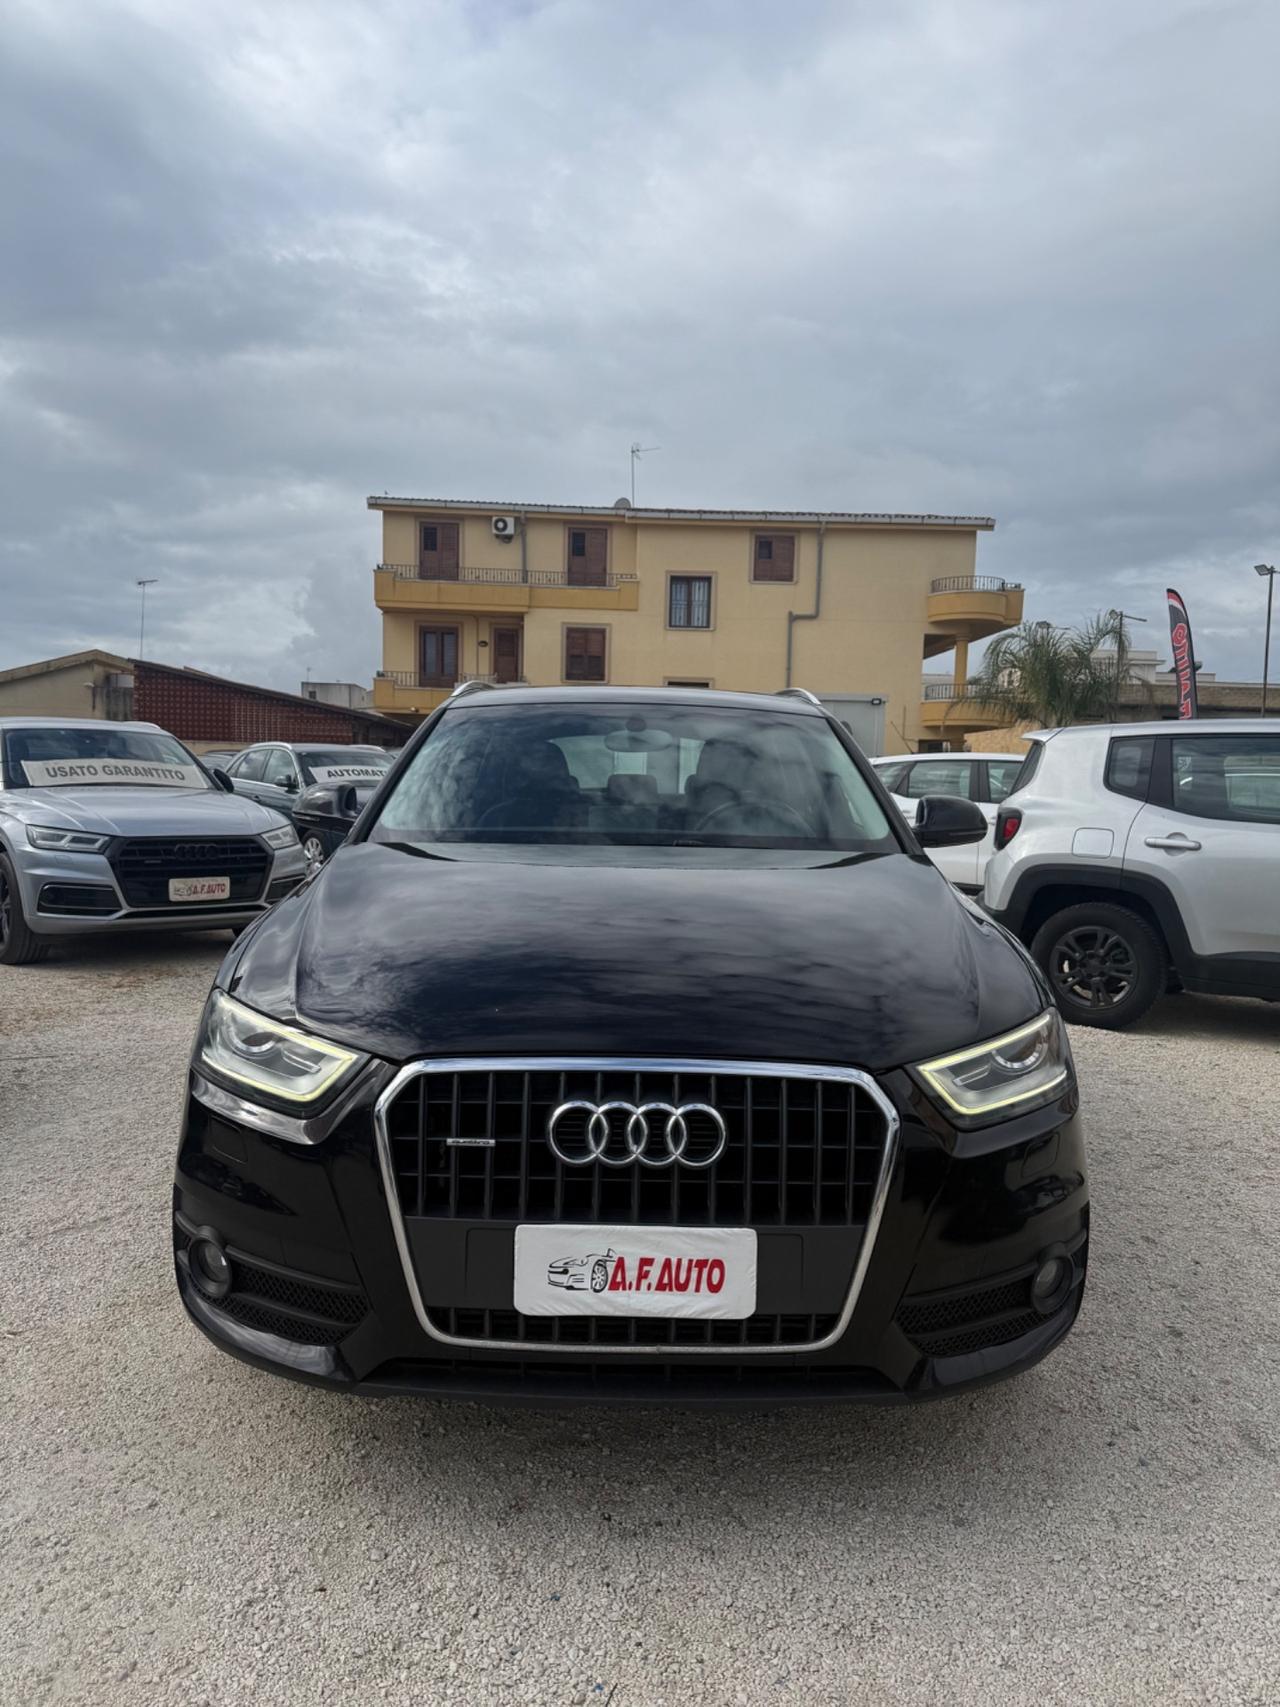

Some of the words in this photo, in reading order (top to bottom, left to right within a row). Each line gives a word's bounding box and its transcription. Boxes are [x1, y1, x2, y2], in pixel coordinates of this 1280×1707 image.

[45, 765, 98, 778] USATO
[102, 765, 186, 781] GARANTITO
[327, 768, 387, 778] AUTOMAT
